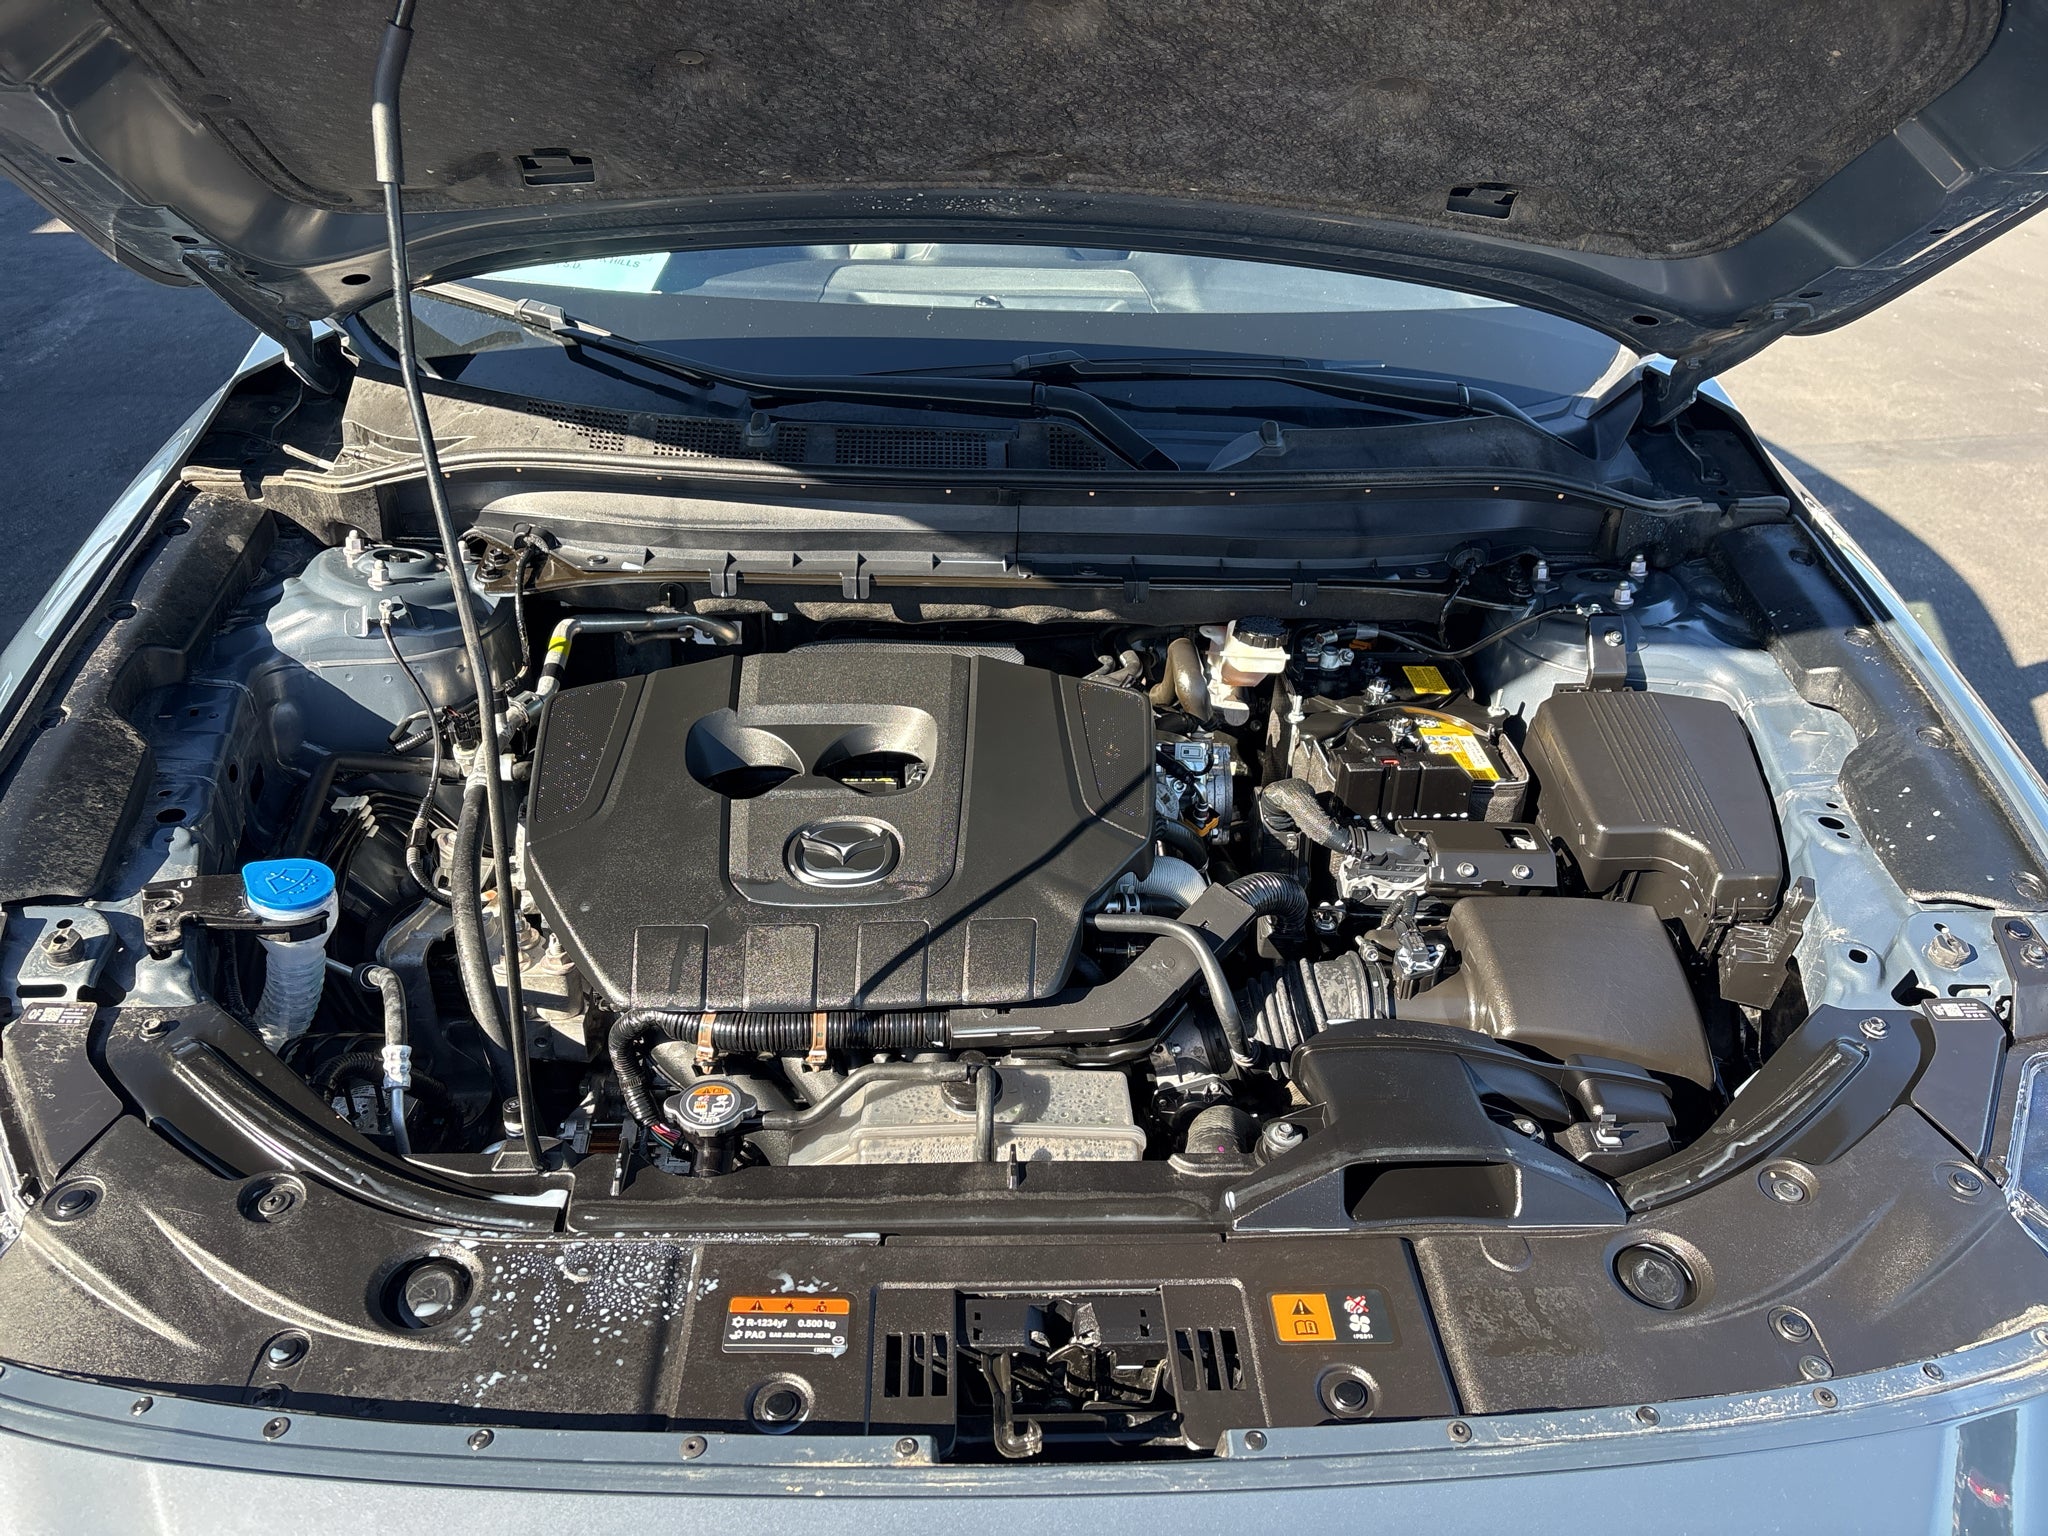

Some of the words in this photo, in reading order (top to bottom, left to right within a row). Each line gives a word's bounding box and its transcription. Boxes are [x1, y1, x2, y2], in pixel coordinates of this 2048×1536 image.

[746, 1318, 788, 1329] R-1234yf
[797, 1319, 823, 1328] 0.500
[824, 1319, 837, 1330] kg
[744, 1330, 766, 1339] PAG
